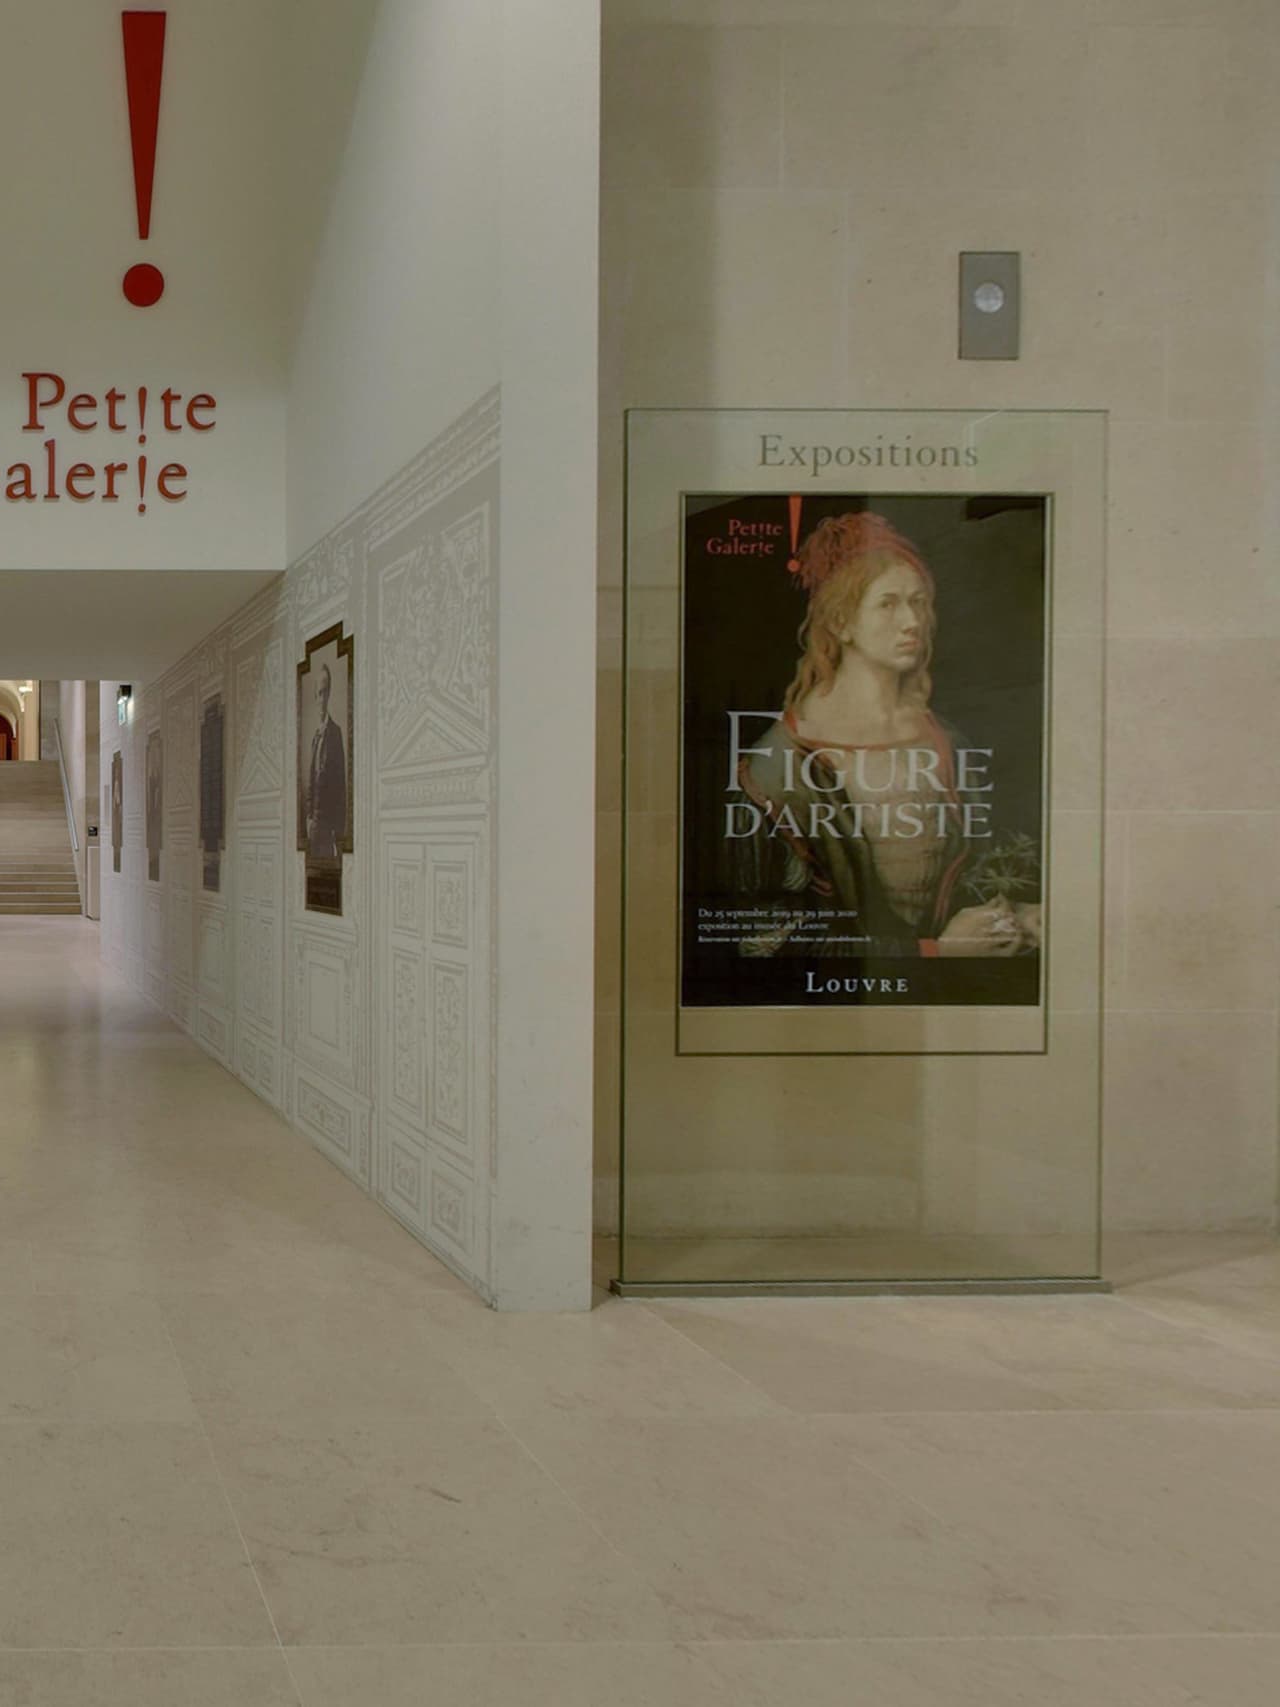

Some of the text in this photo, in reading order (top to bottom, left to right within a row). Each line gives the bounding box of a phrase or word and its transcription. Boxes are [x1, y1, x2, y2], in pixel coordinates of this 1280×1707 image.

[758, 434, 979, 477] Expositions
[724, 710, 995, 792] FIGURE
[723, 800, 993, 838] D'ARTISTE
[698, 908, 712, 918] Du
[805, 972, 909, 992] LOUVRE
